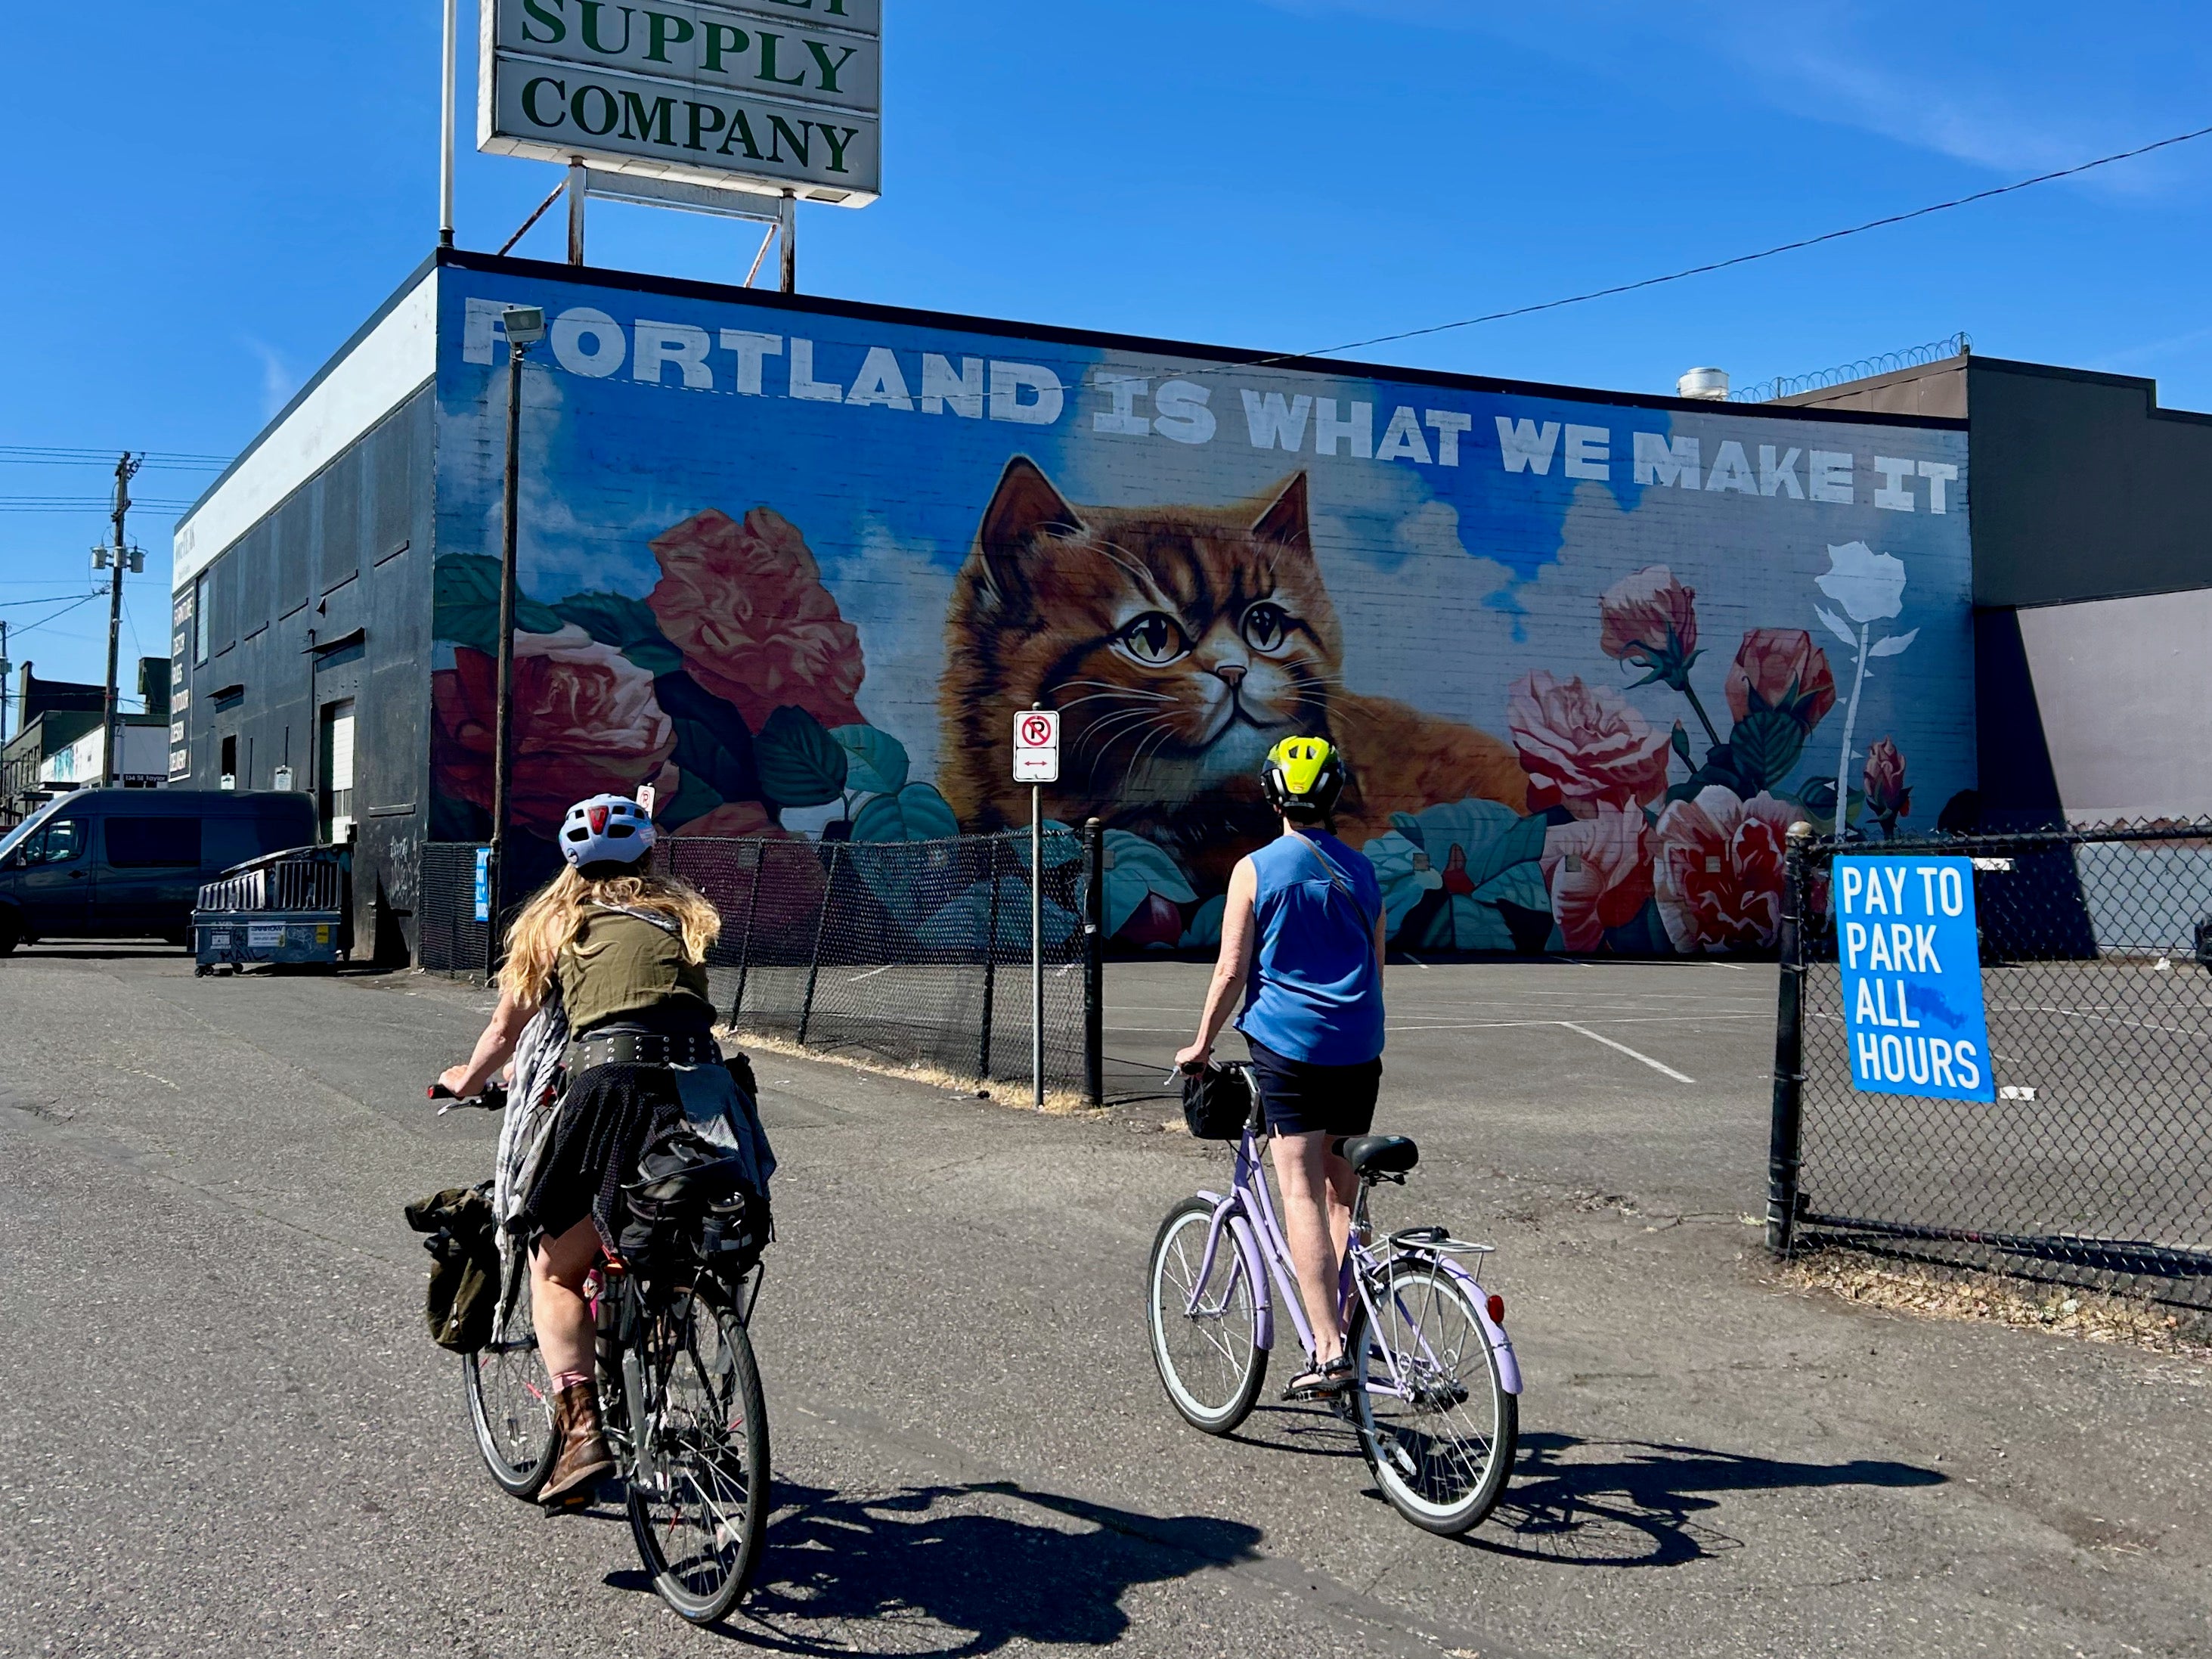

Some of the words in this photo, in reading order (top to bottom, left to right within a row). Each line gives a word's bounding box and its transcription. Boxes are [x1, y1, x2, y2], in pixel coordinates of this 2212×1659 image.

[522, 0, 858, 93] SUPPLY
[522, 77, 859, 173] COMPANY
[463, 297, 1064, 425] PORTLAND
[1093, 371, 1216, 444] IS
[1241, 389, 1472, 467] WHAT
[1495, 416, 1610, 481] WE
[1633, 432, 1854, 504] MAKE
[1874, 455, 1959, 514] IT
[1842, 867, 1907, 916] PAY
[1917, 867, 1964, 917] TO
[1845, 922, 1943, 974] PARK
[1855, 977, 1921, 1028] ALL
[1857, 1032, 1981, 1090] HOURS
